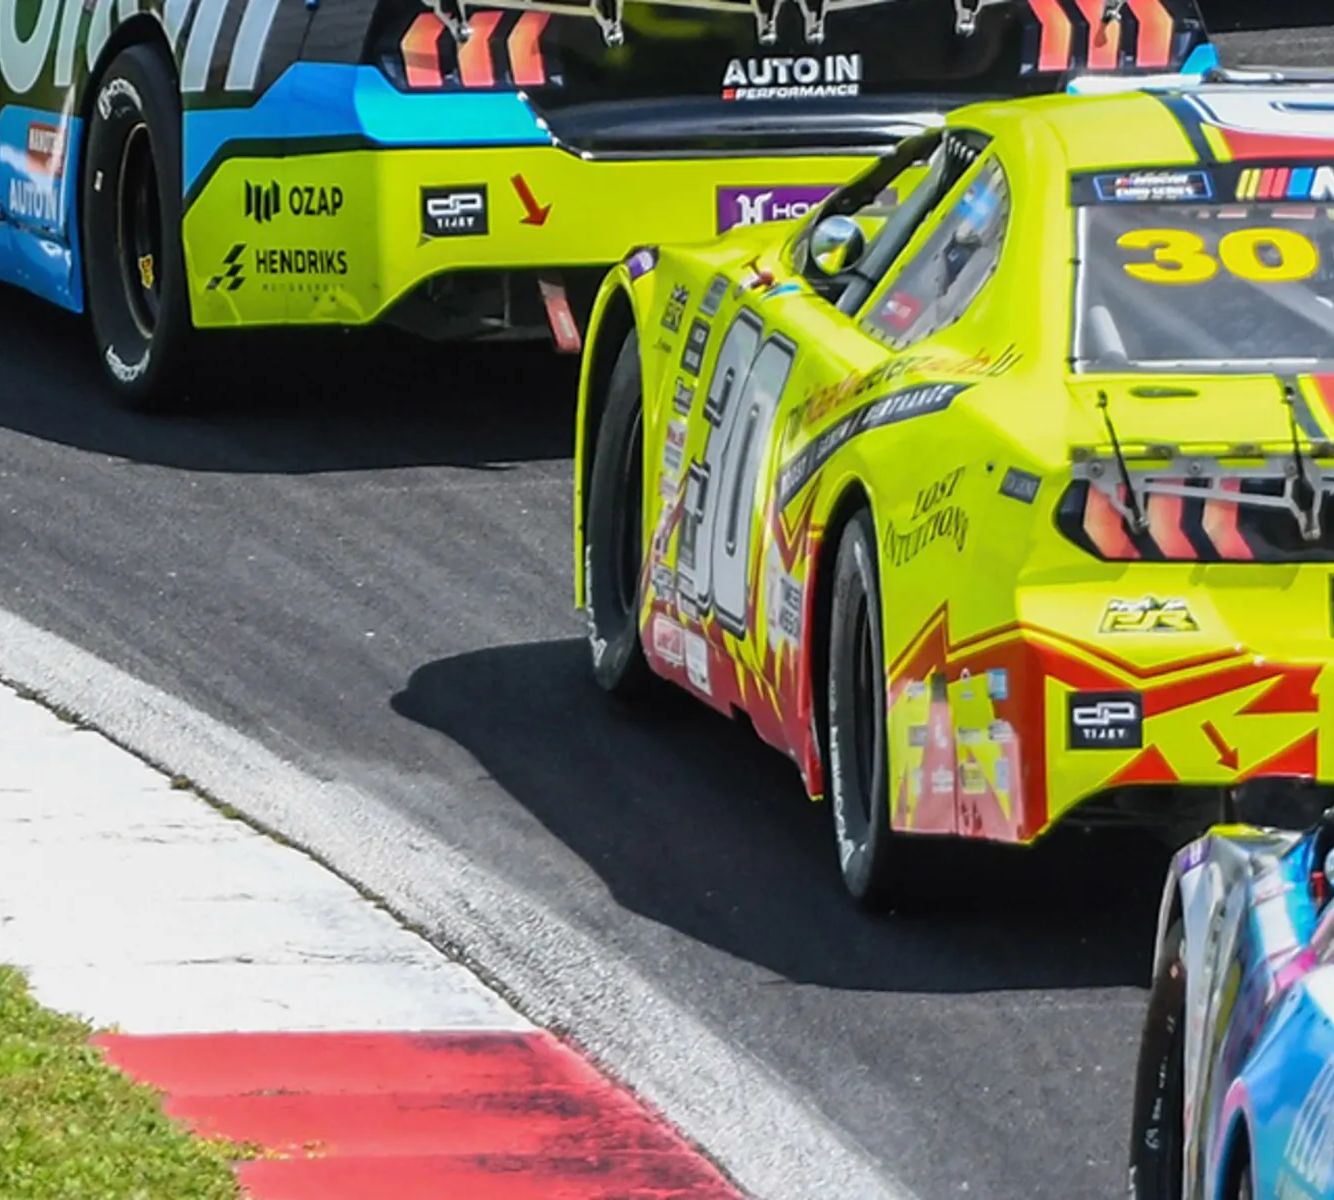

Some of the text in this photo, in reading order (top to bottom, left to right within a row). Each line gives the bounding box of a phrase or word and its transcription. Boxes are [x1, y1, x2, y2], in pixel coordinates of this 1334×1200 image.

[722, 54, 862, 87] AUTO IN
[736, 84, 859, 100] PERFORMANCE
[288, 186, 344, 216] OZAP
[255, 249, 348, 275] HENDRIKS
[1116, 227, 1320, 284] 30
[910, 466, 966, 522] LOST
